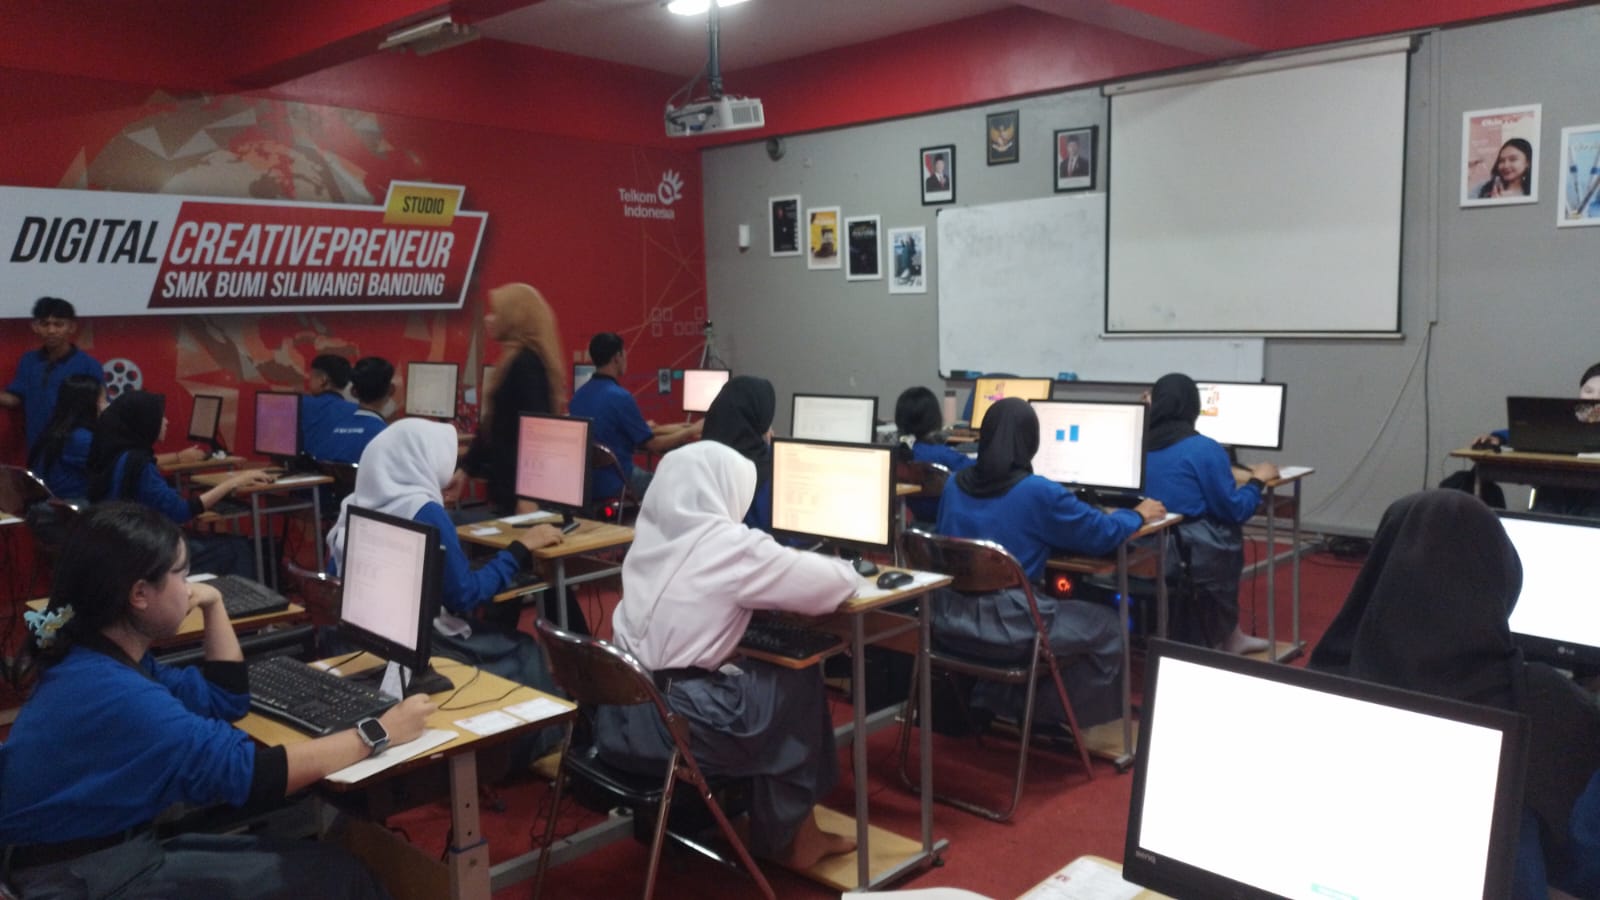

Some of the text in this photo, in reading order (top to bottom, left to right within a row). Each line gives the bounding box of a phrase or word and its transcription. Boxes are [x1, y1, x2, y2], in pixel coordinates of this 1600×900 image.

[402, 195, 446, 215] STUDIO
[617, 187, 657, 204] Telkom
[624, 204, 676, 220] Indonesia
[9, 216, 456, 269] DIGITAL CREATIVEPRENEUR
[161, 271, 446, 298] SMK BUMI SILIWANGI BANDUNG
